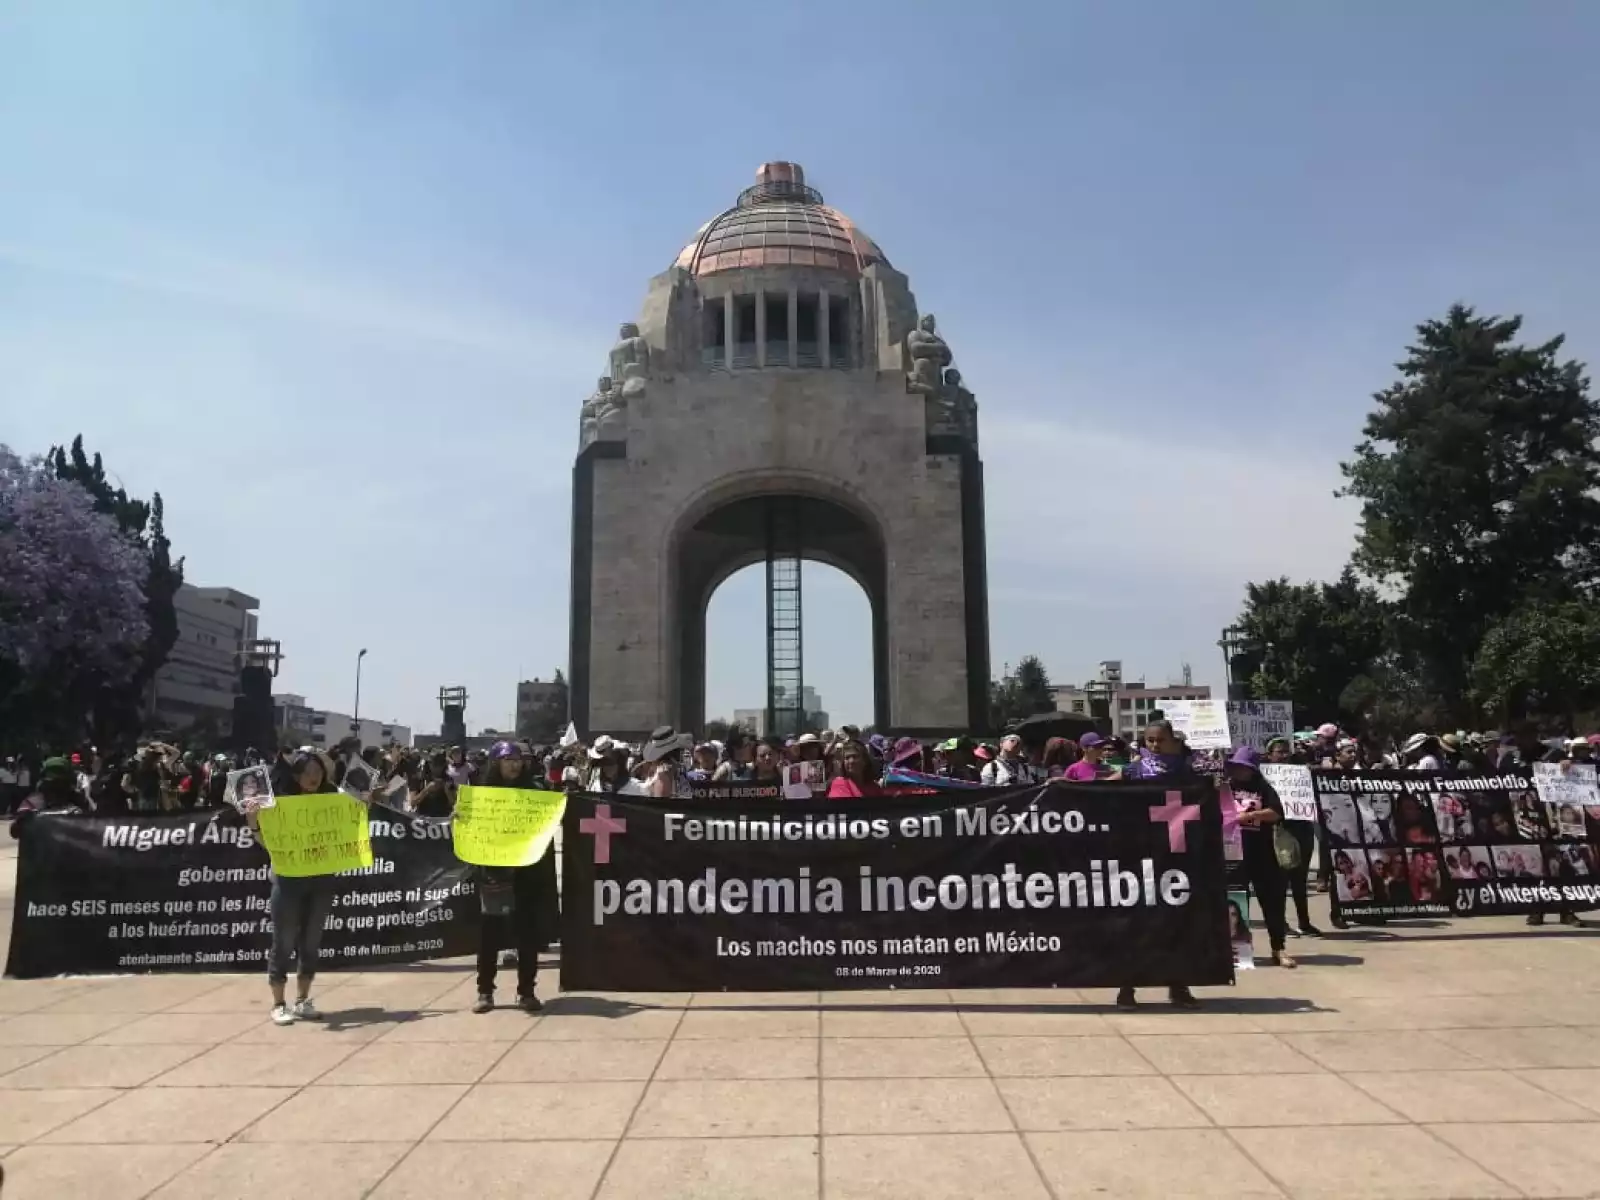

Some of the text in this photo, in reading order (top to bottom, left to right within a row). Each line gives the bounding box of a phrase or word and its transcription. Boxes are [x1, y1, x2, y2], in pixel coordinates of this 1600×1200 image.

[1317, 775, 1402, 791] Huérfanos
[1404, 780, 1431, 794] por
[1434, 774, 1528, 791] Feminicidio
[102, 823, 195, 851] Miguel
[200, 815, 254, 848] Áng
[664, 813, 889, 841] Feminicidios
[900, 814, 943, 838] en
[27, 901, 67, 918] hace
[71, 899, 107, 916] SEIS
[110, 900, 161, 915] meses
[164, 900, 193, 916] que
[196, 899, 217, 912] no
[220, 896, 242, 912] les
[342, 889, 402, 908] cheques
[406, 887, 421, 901] ni
[424, 886, 449, 901] sus
[593, 858, 1191, 925] pandemia incontenible
[1456, 880, 1600, 910] ¿y el interés supe
[108, 925, 118, 938] a
[122, 922, 145, 938] los
[149, 920, 229, 936] huérfanos
[231, 920, 257, 937] por
[347, 915, 375, 934] que
[377, 906, 454, 930] protegiste
[118, 953, 192, 965] atentamente
[195, 951, 235, 963] Sandra
[236, 949, 262, 961] Soto
[372, 943, 401, 955] Marzo
[417, 938, 444, 950] 2020
[716, 931, 1061, 957] Los machos nos matan en México
[851, 966, 864, 976] de
[865, 965, 898, 976] Marzo
[899, 965, 912, 975] de
[913, 964, 941, 975] 2020
